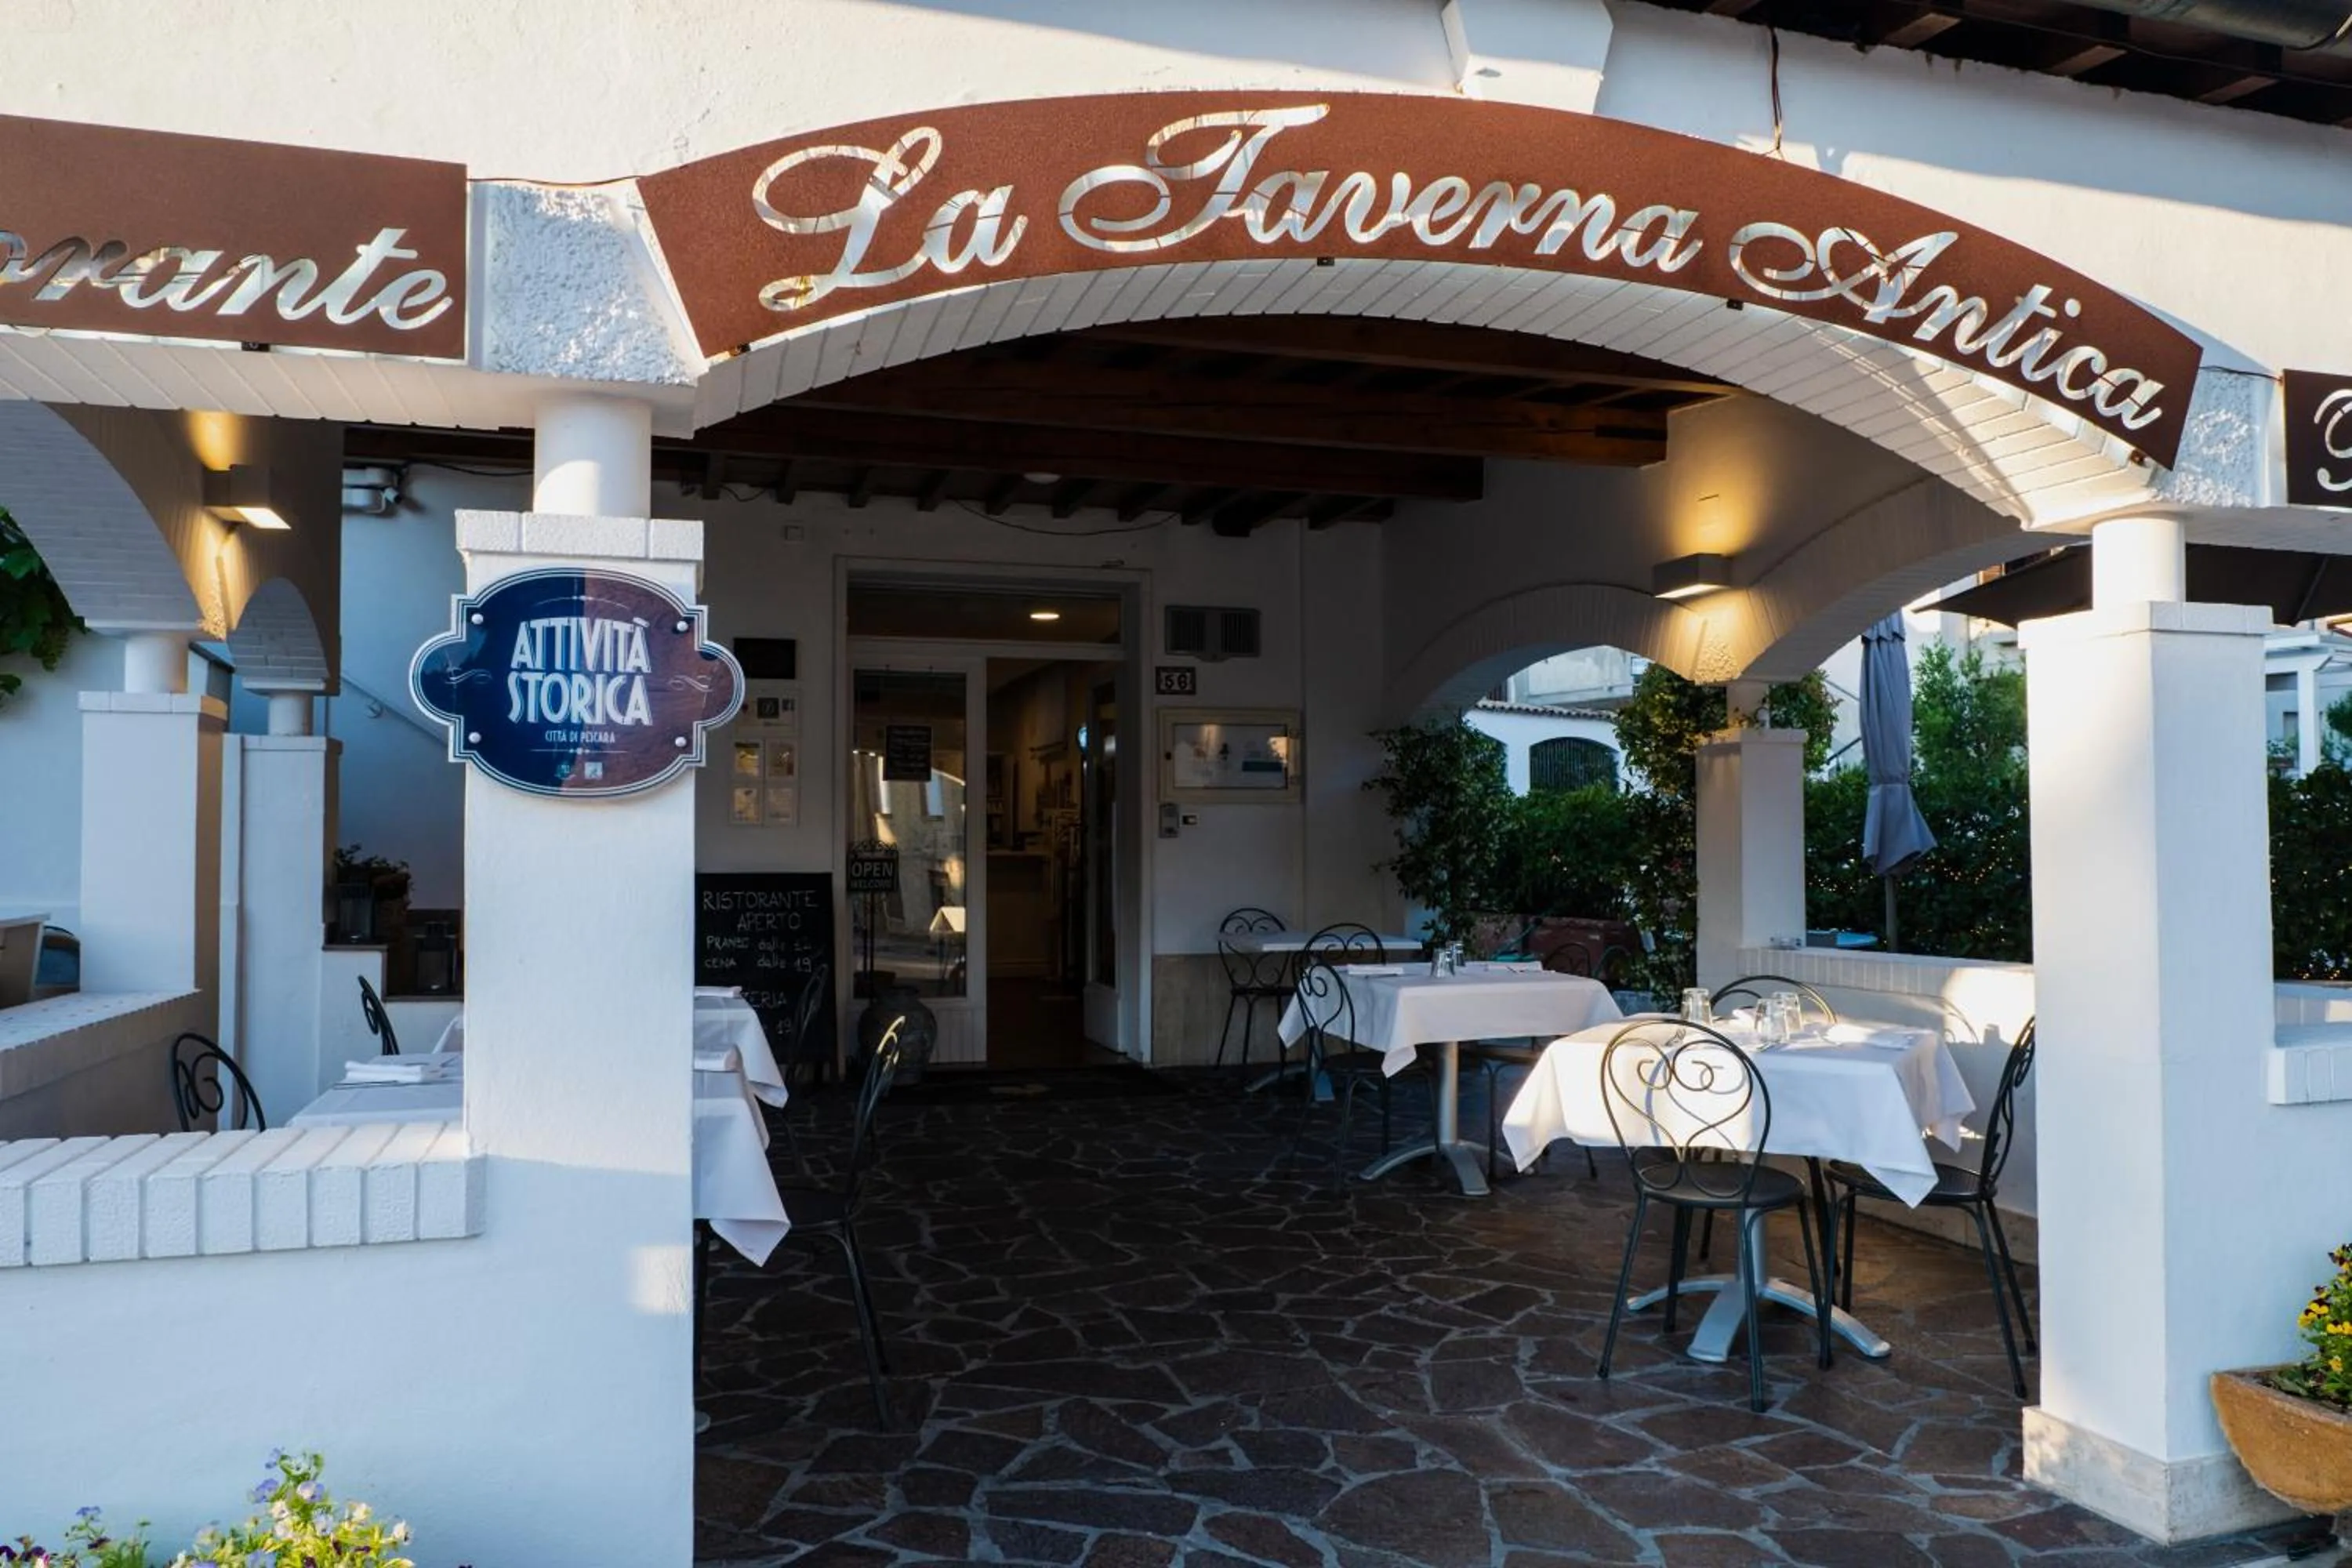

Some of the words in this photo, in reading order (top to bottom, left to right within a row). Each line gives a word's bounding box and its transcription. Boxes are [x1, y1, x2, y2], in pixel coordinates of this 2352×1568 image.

[752, 125, 1029, 312] La
[1058, 103, 1703, 273] Taverna
[1728, 221, 2165, 431] Antica
[510, 617, 652, 673] ATTIVITÀ
[506, 671, 653, 726] STORICA
[851, 861, 893, 877] OPEN
[702, 889, 820, 911] RISTORANTE
[737, 912, 801, 932] APERTO
